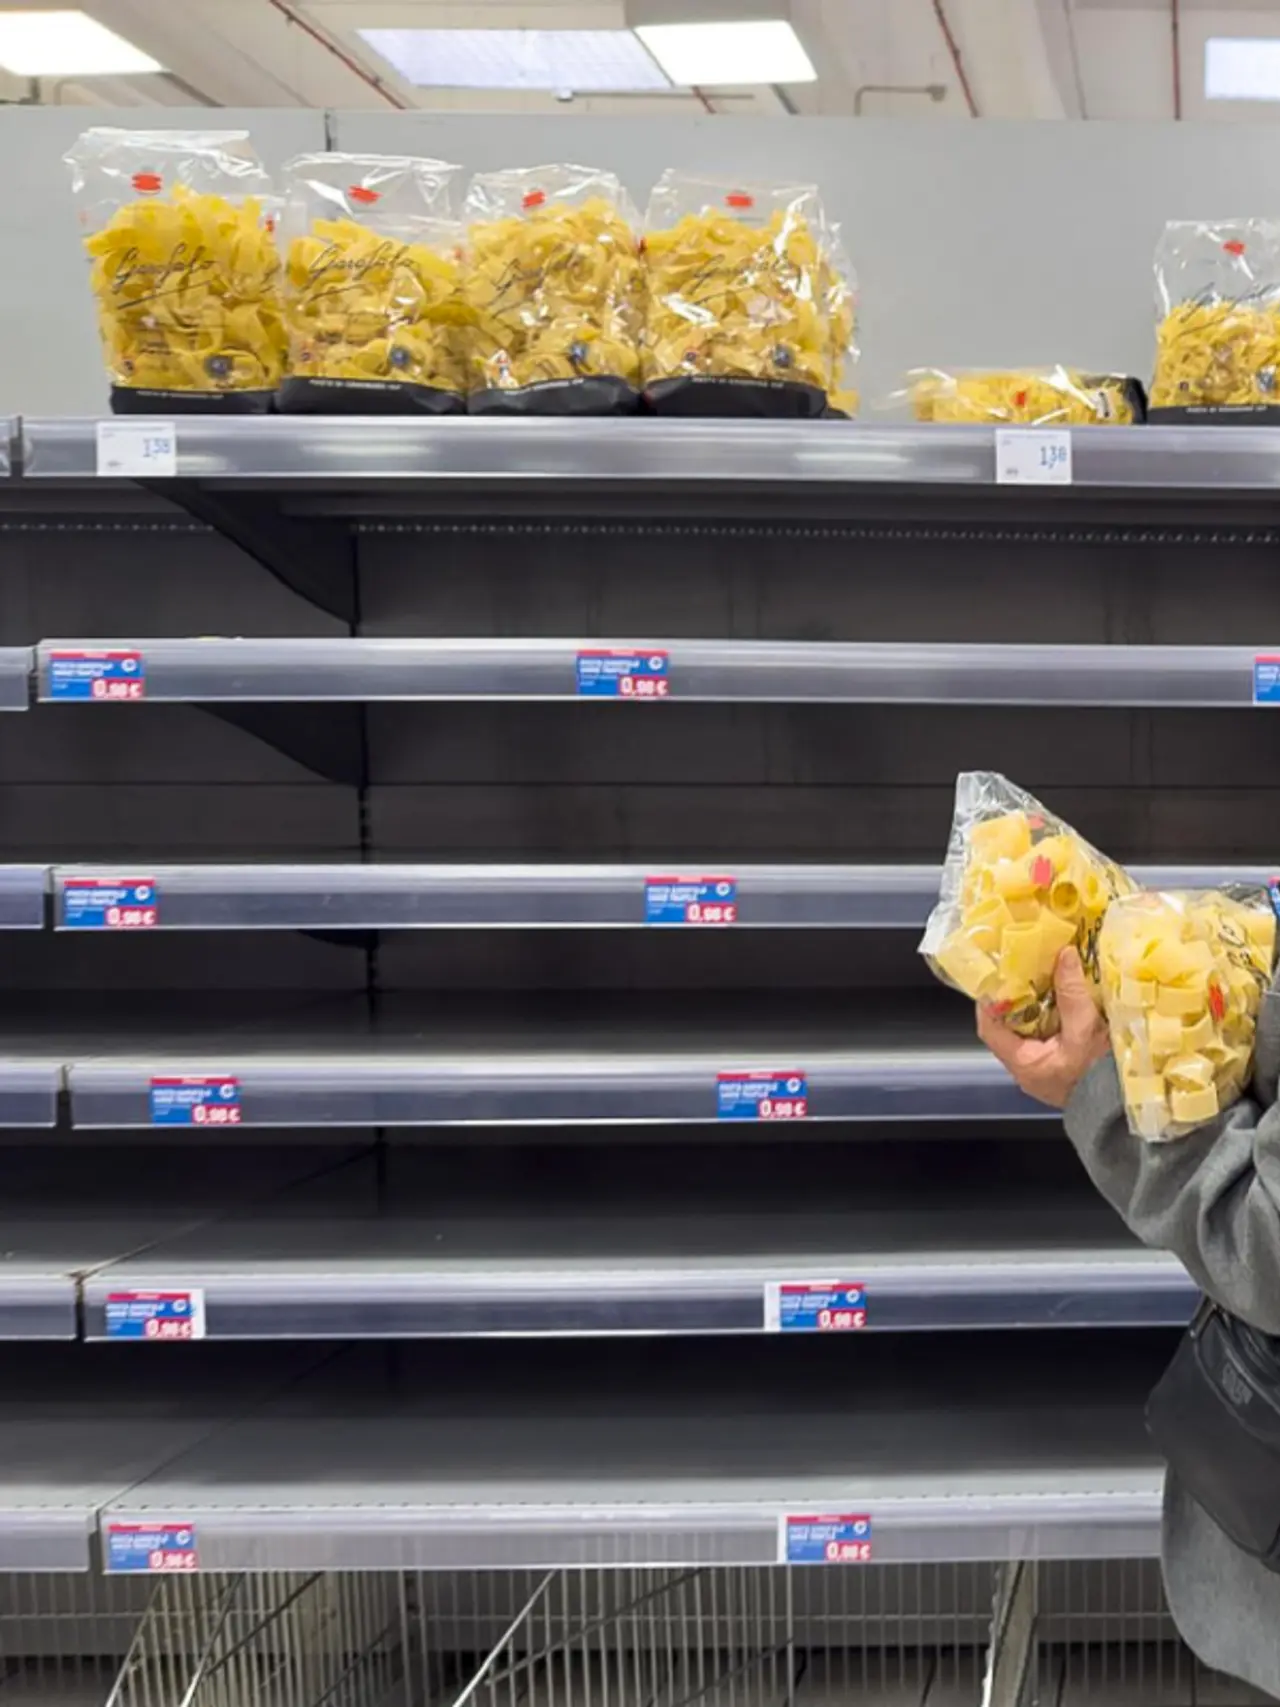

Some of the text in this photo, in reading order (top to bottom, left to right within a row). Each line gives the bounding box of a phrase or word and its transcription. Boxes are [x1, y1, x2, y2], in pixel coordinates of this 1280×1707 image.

[302, 241, 414, 291] Garofalo
[129, 683, 141, 697] €
[657, 680, 667, 694] €
[144, 911, 154, 924] €
[724, 907, 734, 920] €
[229, 1108, 239, 1121] €
[795, 1102, 804, 1115] €
[854, 1313, 864, 1327] €
[181, 1322, 191, 1336] €
[860, 1545, 870, 1559] €
[185, 1554, 195, 1567] €
